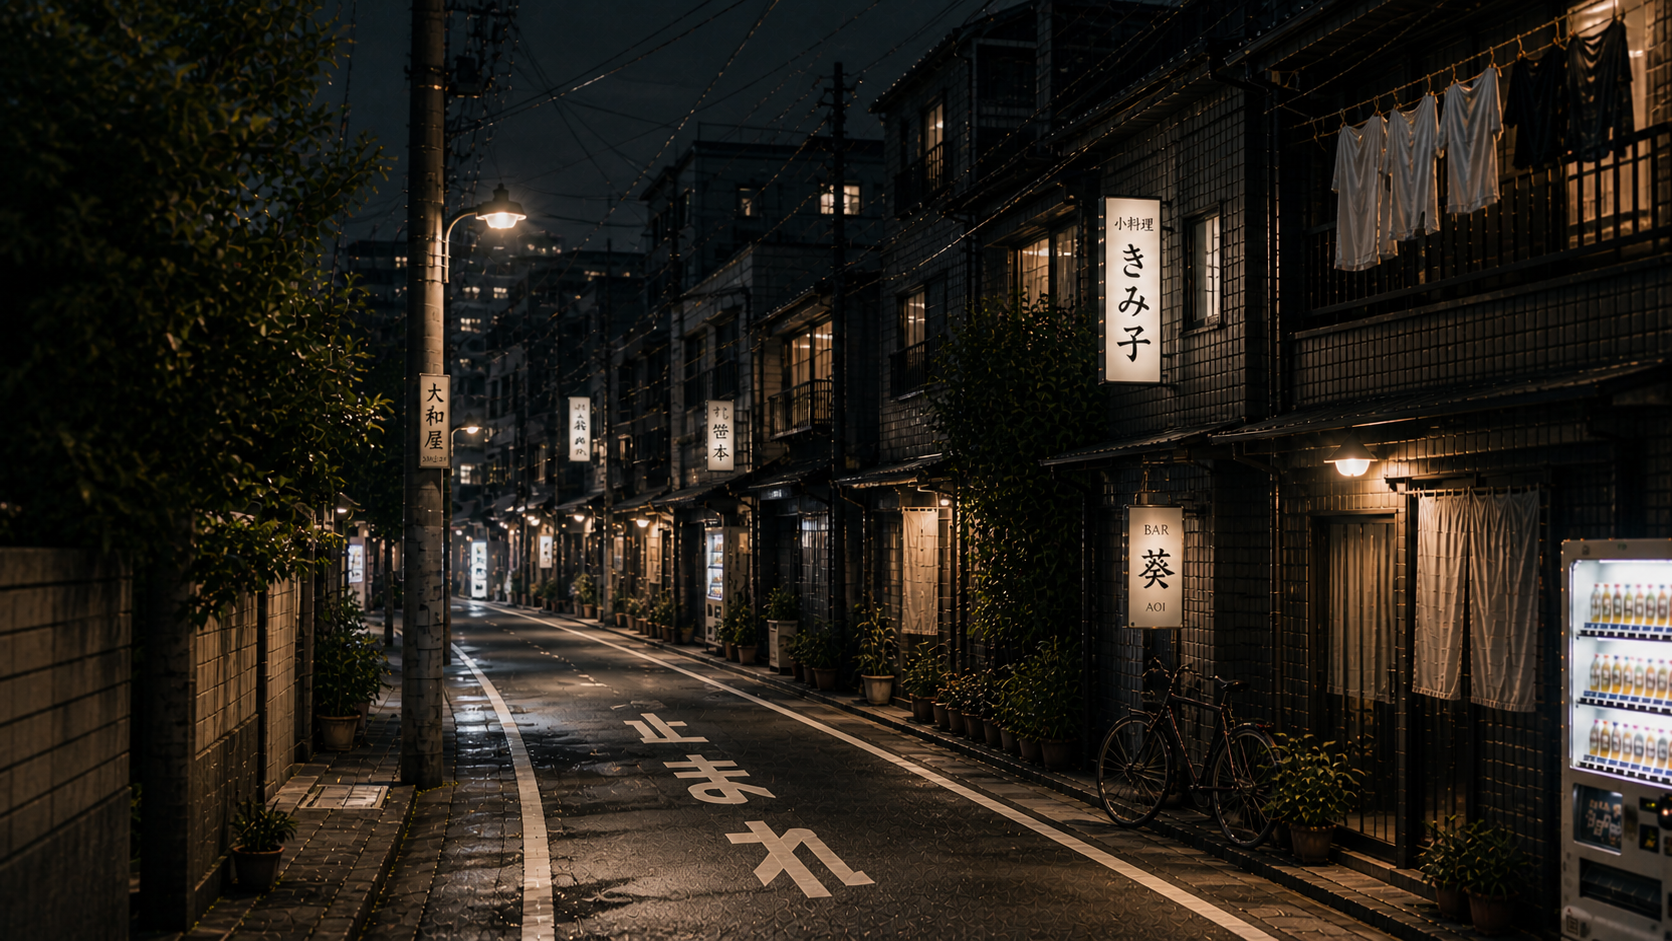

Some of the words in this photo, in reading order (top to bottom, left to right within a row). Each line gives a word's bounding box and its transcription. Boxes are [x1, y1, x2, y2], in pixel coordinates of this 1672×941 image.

[1115, 216, 1154, 232] 小料理
[1117, 243, 1152, 363] きみ子
[424, 382, 444, 449] 大和屋
[1144, 525, 1169, 535] BAR
[1138, 548, 1175, 589] 葵
[1145, 602, 1166, 612] AOI
[623, 713, 876, 898] 止まれ
